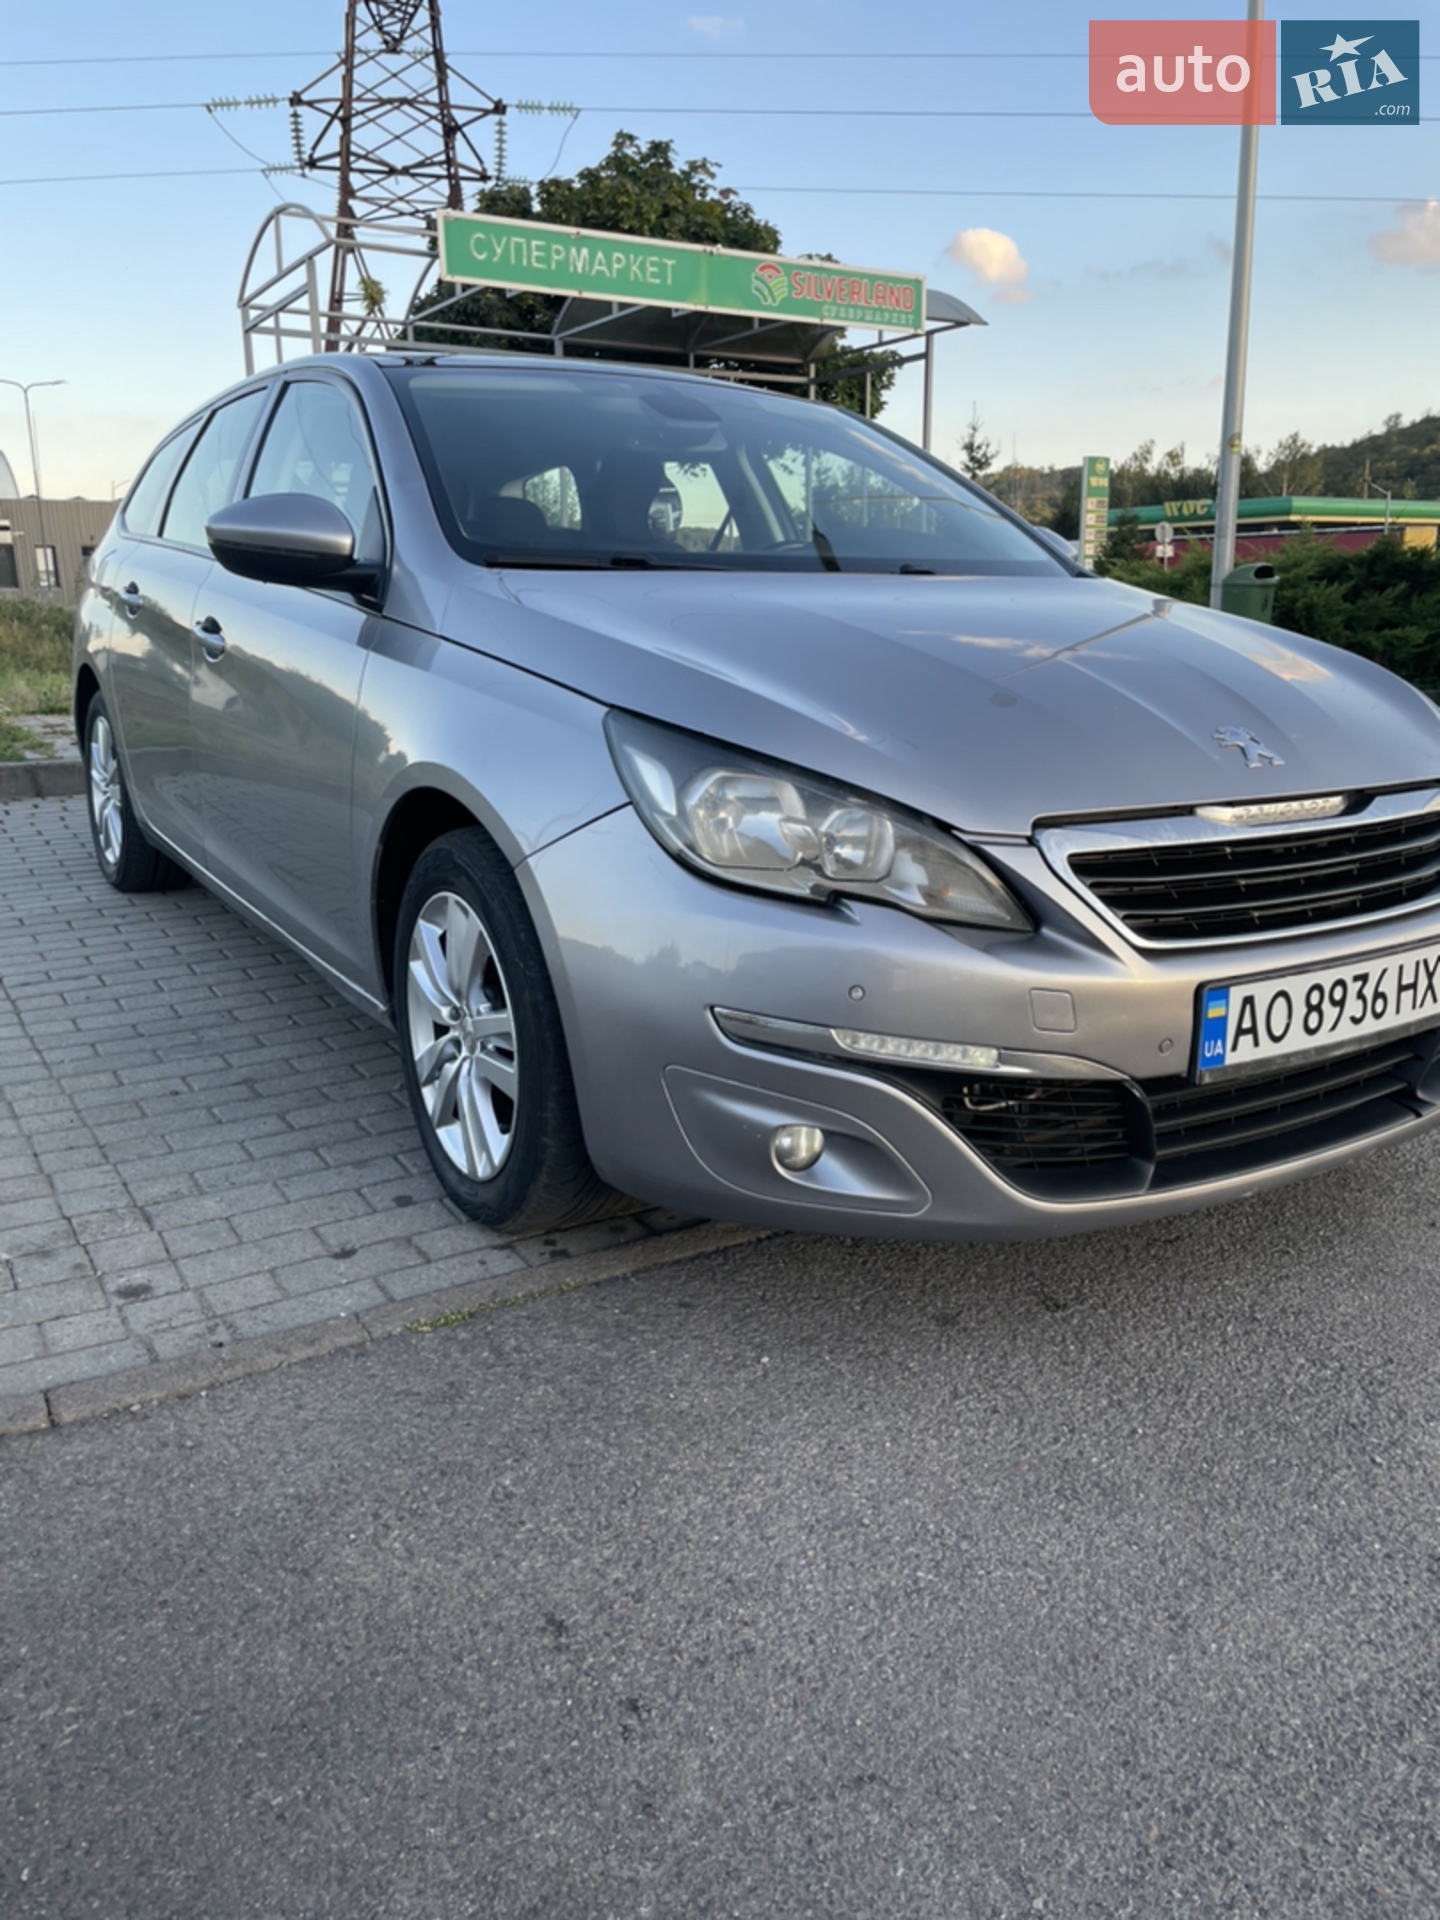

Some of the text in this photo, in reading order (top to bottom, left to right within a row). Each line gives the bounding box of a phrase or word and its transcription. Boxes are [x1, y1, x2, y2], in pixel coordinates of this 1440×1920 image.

[470, 232, 677, 286] СУПЕРМАРКЕТ
[791, 269, 915, 313] SILVERLAND
[1230, 954, 1440, 1053] AO 8936 HX
[1204, 1038, 1224, 1058] UA
